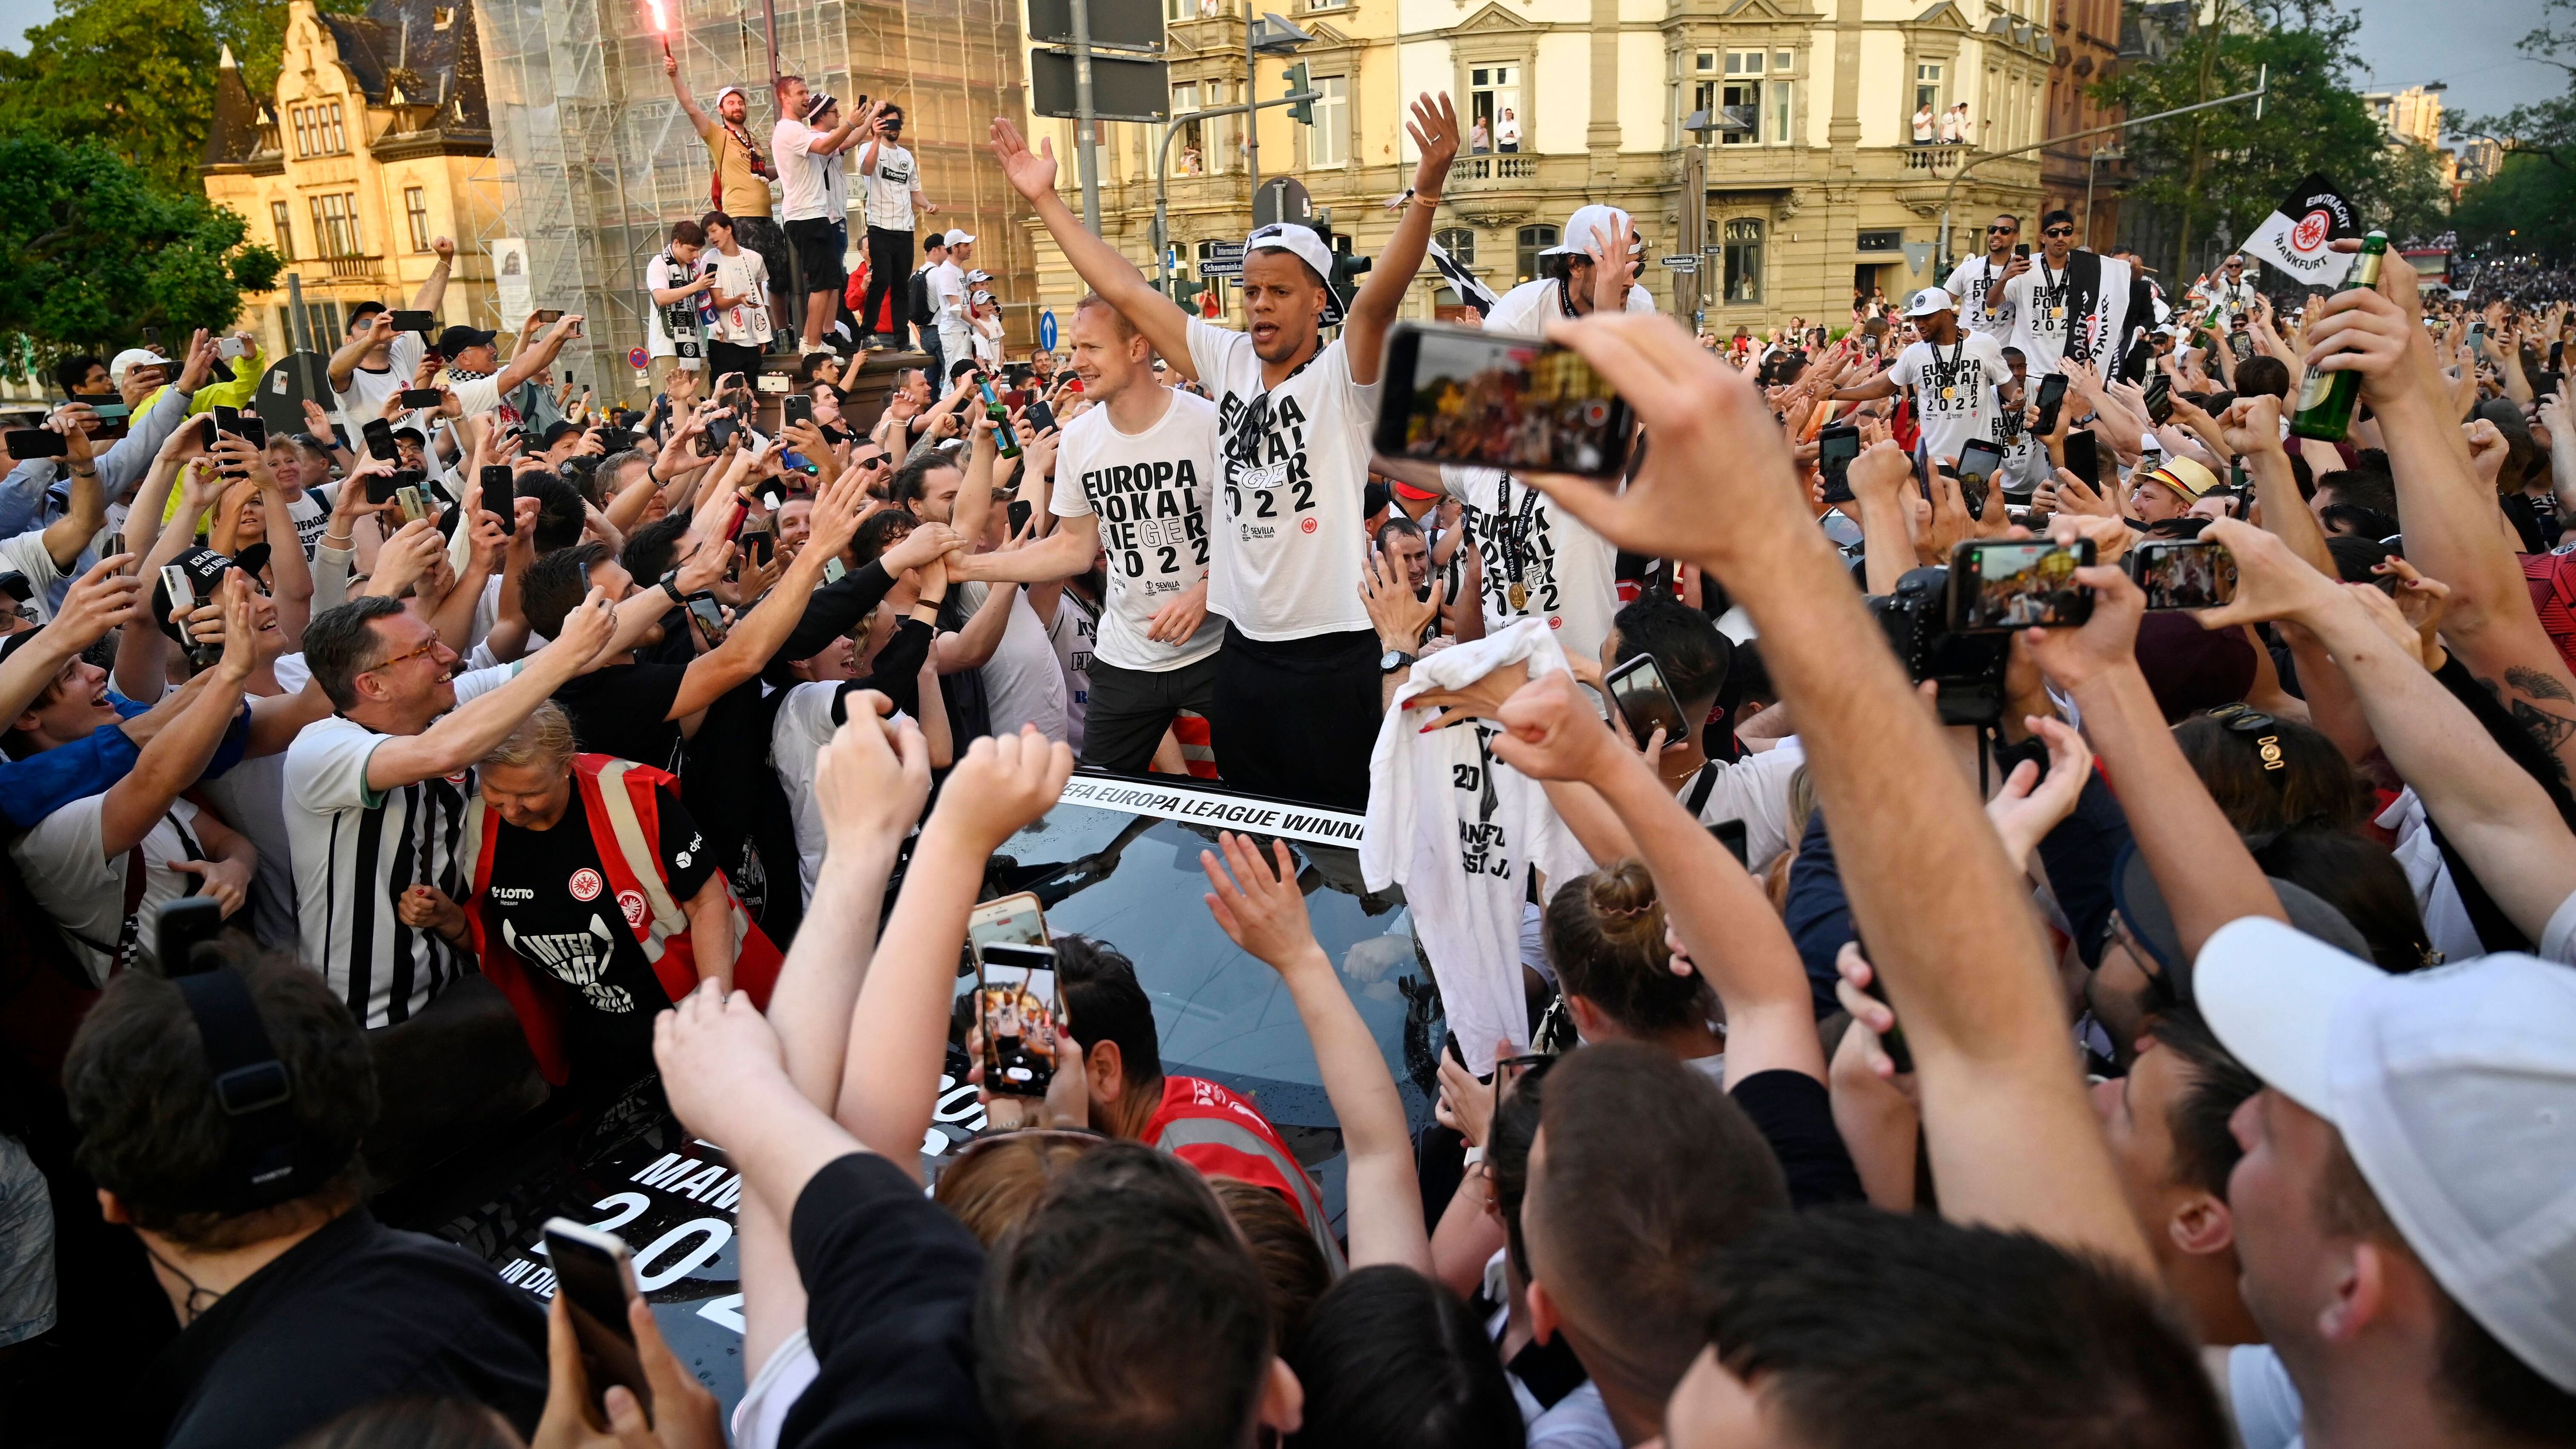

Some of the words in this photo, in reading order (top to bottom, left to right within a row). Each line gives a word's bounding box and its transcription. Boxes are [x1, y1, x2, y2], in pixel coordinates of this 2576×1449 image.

[886, 169, 906, 180] indeed
[2306, 193, 2351, 229] EINTRACHT
[2274, 232, 2328, 270] FRANKFURT
[1204, 263, 1243, 272] Schaumainka
[673, 272, 687, 334] EINTRHT
[2032, 318, 2069, 331] 202
[1922, 360, 1981, 377] EUROPA
[1923, 372, 1979, 389] POKAL
[1927, 396, 1977, 411] 2022
[1081, 459, 1198, 500] EUROPA
[1517, 516, 1526, 538] SEVILLA
[1522, 495, 1534, 516] FINAL
[1250, 526, 1275, 535] SEVILLA
[1504, 536, 1513, 558] SEVILLA
[1507, 557, 1516, 580] FINAL
[1155, 581, 1180, 589] SEVILLA
[1099, 787, 1181, 812] EUROPA
[1180, 799, 1281, 826] LEAGUE
[689, 831, 703, 853] dpd
[501, 888, 534, 899] LOTTO
[519, 932, 595, 966] INTER
[498, 1258, 531, 1284] IN
